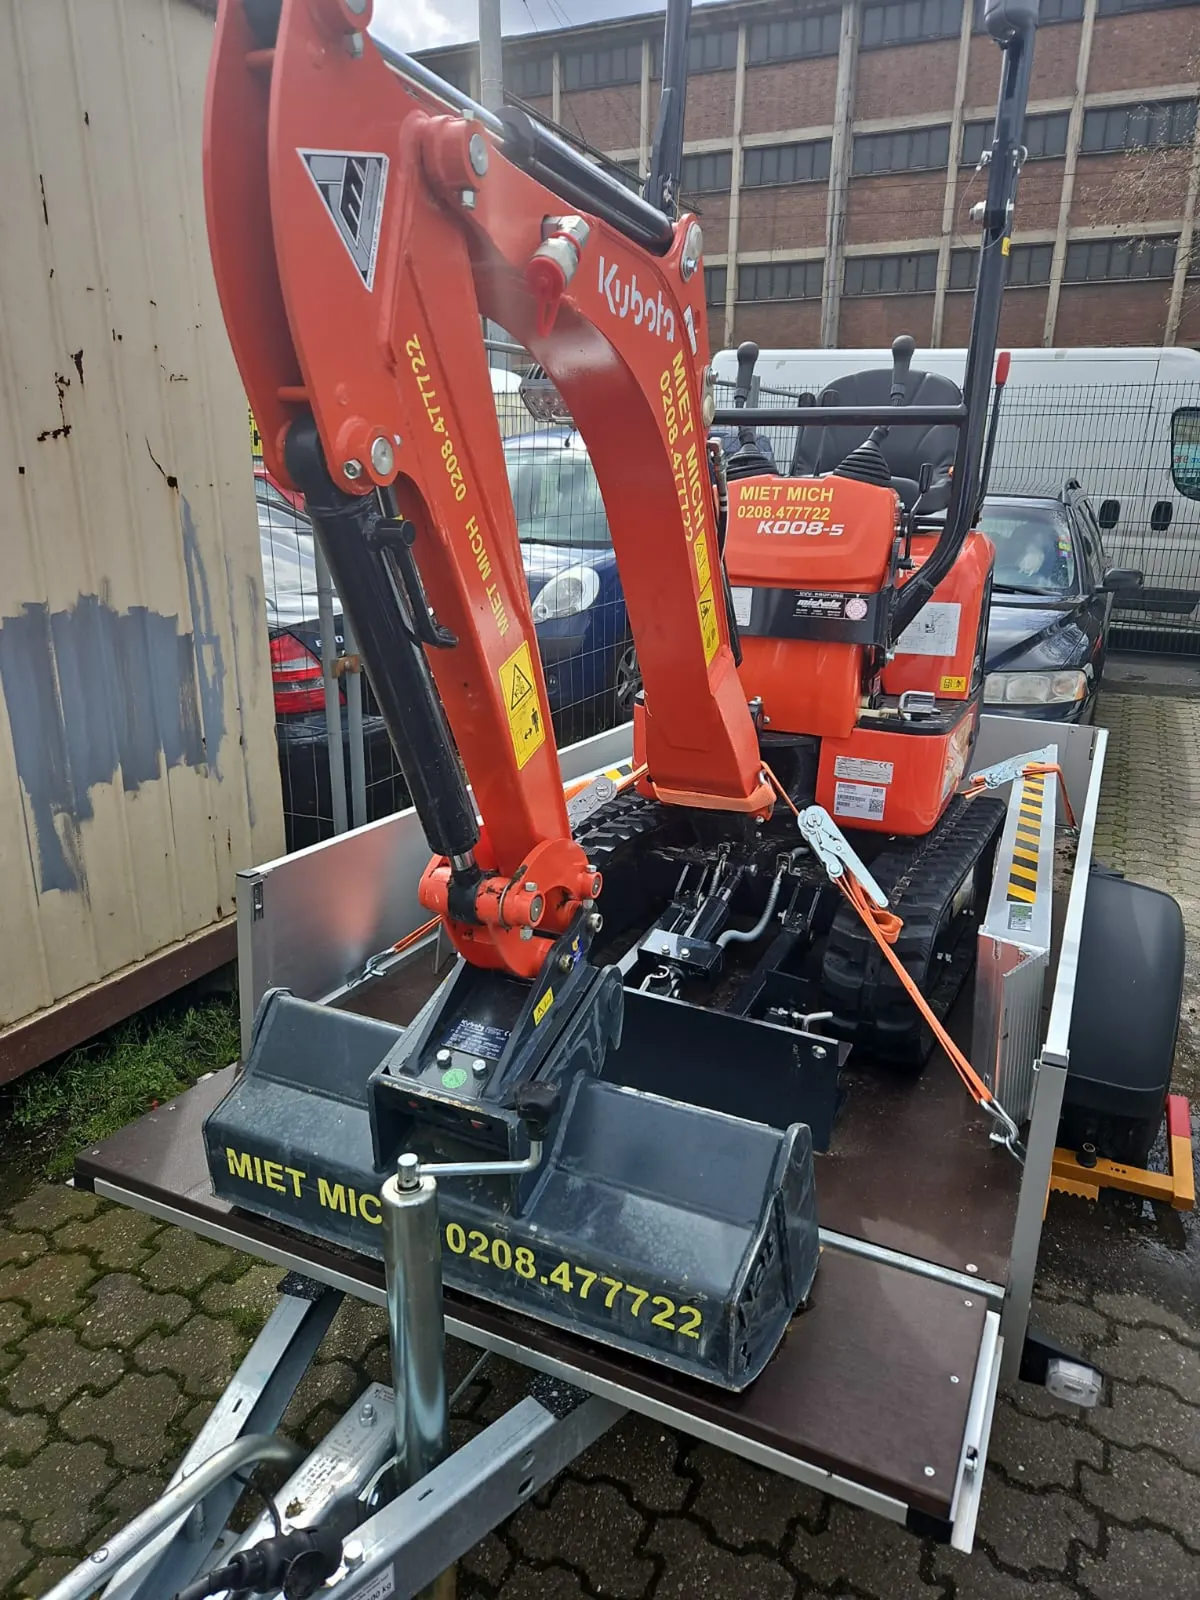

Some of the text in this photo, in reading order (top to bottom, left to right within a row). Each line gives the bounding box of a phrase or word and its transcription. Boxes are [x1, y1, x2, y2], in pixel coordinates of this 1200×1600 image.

[598, 256, 675, 343] Kubota
[405, 332, 510, 638] MIET MICH 0208.477722
[659, 369, 694, 543] 0208.477722
[672, 349, 706, 530] MIET MICH
[739, 486, 834, 502] MIET MICH
[737, 505, 831, 521] 0208.477722
[757, 520, 845, 536] K008-5
[226, 1147, 703, 1340] MIET MIC 0208.477722
